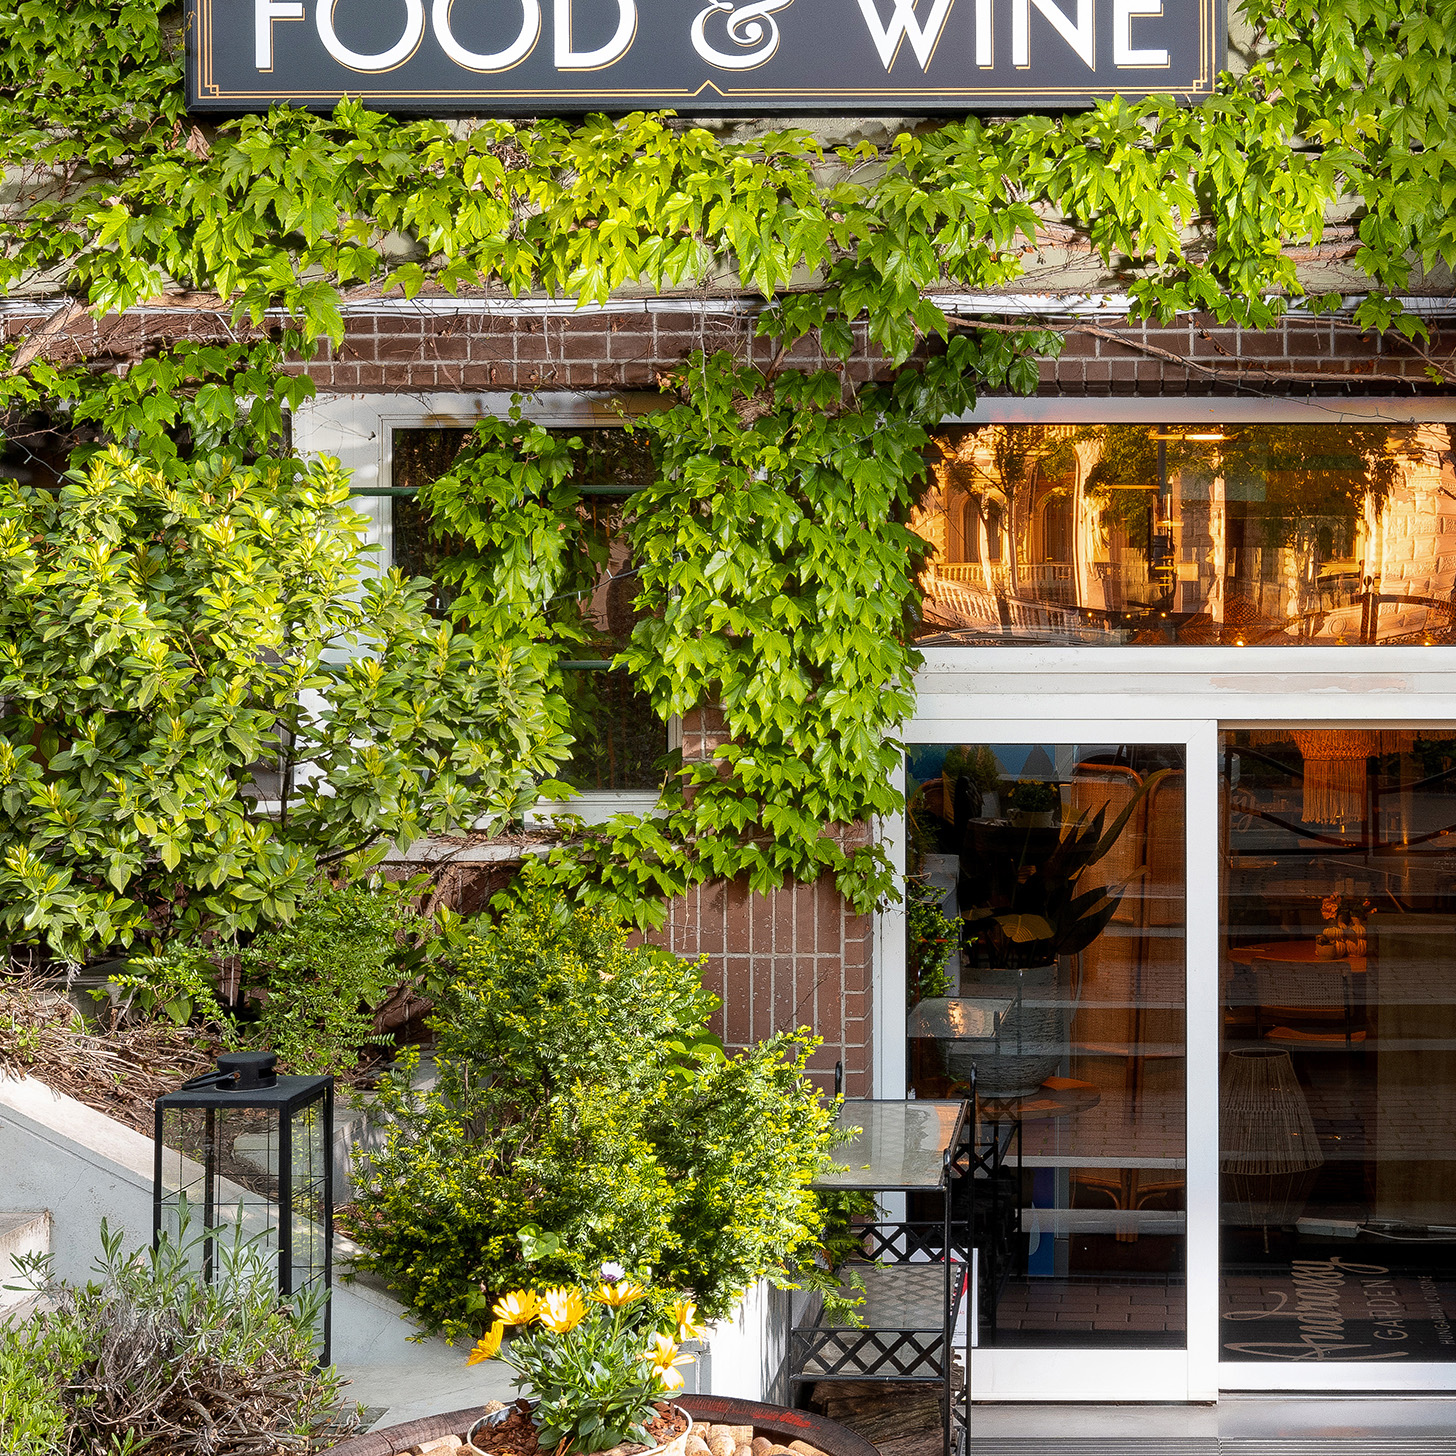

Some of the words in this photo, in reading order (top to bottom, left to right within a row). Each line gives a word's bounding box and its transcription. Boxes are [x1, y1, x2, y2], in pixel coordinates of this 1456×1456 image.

[1222, 1256, 1410, 1362] Andrassy
[1359, 1278, 1410, 1341] GARDEN
[1426, 1301, 1456, 1346] HUNGARIAN
